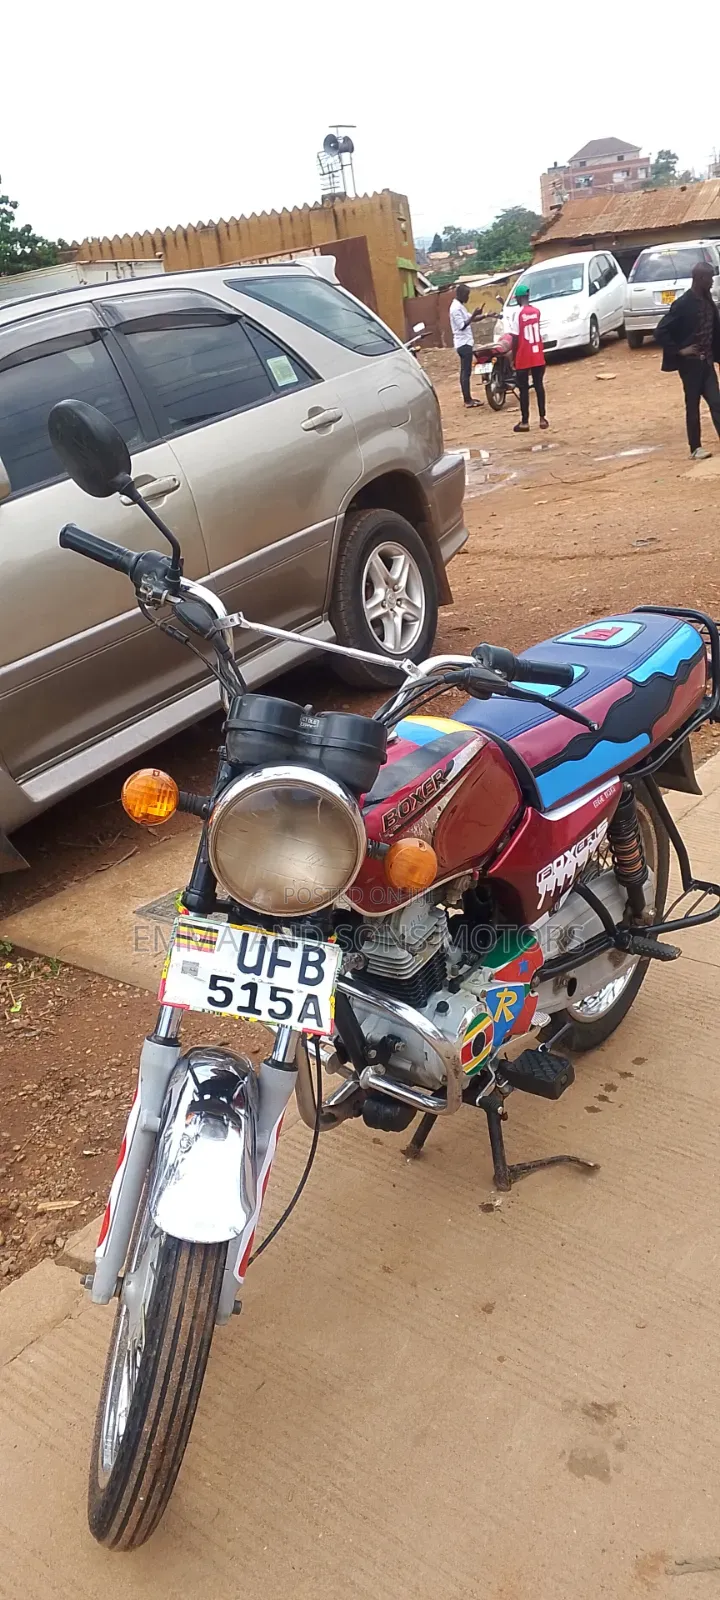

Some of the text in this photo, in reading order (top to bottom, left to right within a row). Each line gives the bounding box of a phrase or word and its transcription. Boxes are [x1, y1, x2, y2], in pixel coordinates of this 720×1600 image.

[382, 768, 448, 833] BOXER
[237, 932, 327, 987] UFB
[207, 974, 324, 1027] 515A
[493, 987, 518, 1023] R
